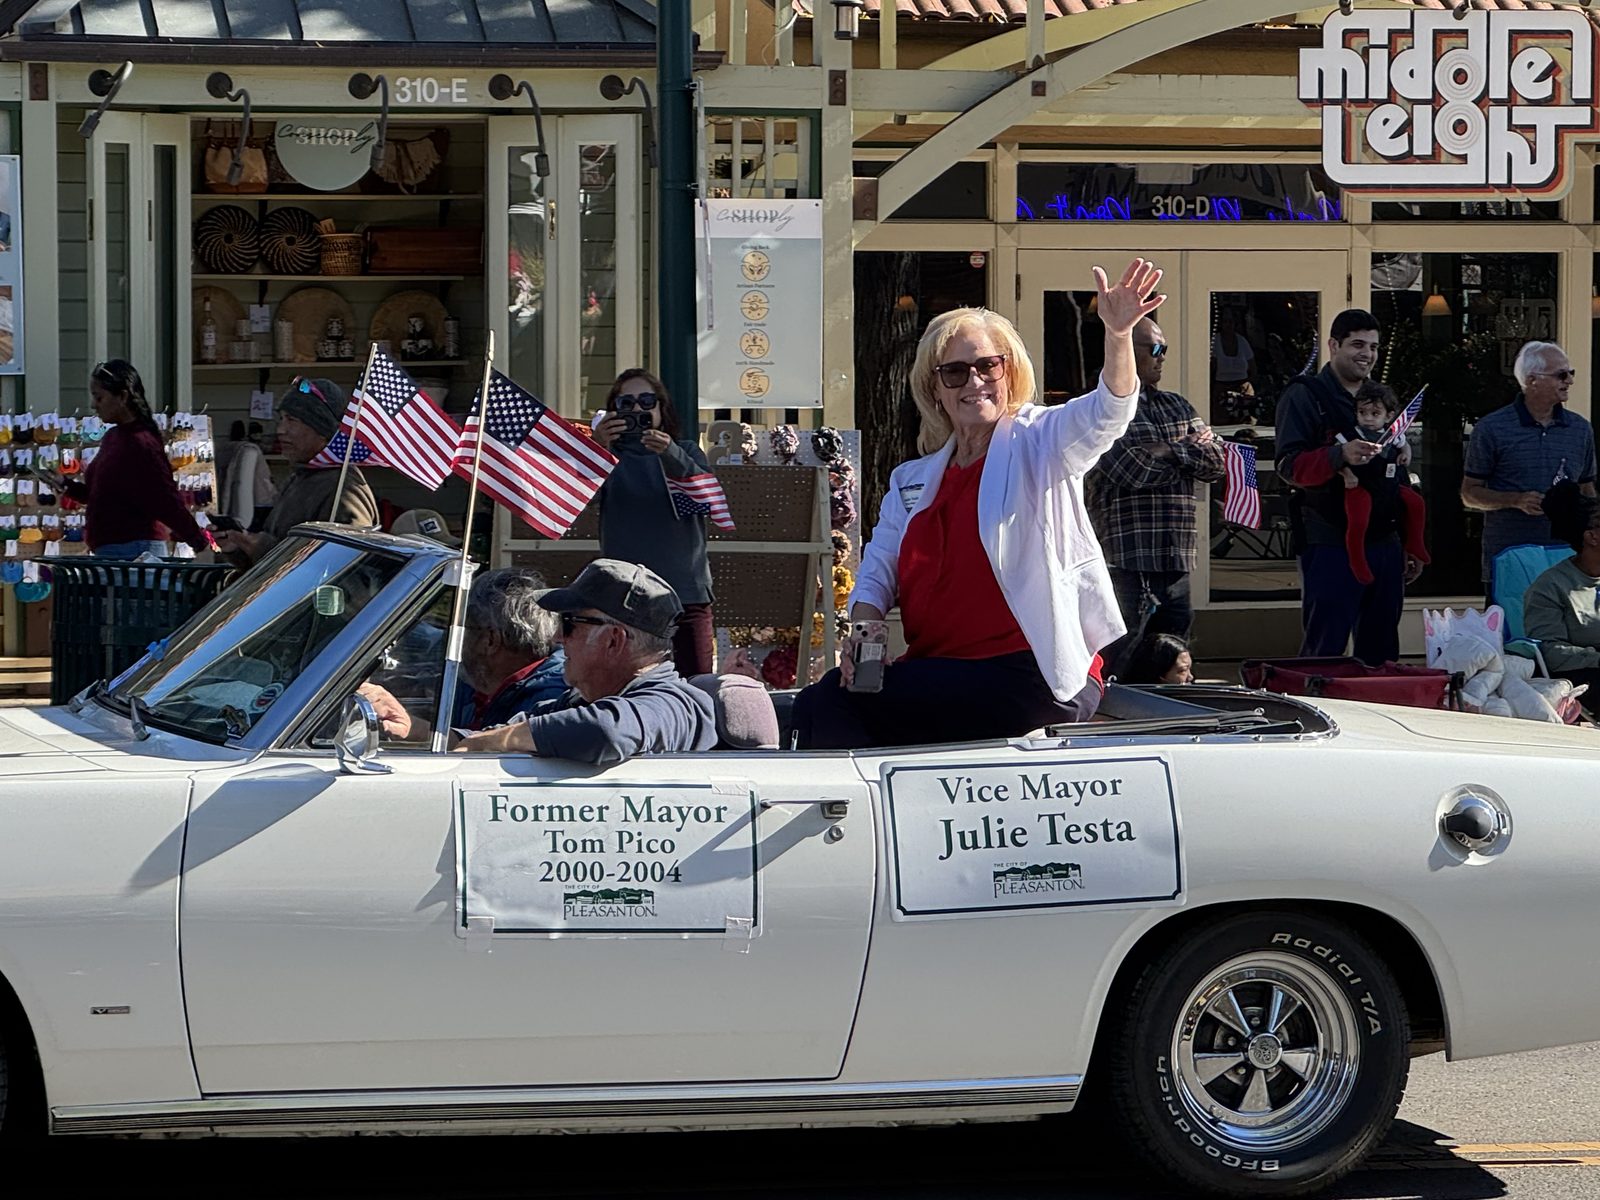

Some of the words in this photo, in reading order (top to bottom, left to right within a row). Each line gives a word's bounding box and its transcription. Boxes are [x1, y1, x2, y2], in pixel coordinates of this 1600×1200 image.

[1299, 9, 1592, 100] middle
[395, 77, 468, 103] 310-E
[296, 127, 358, 146] SHOP
[732, 209, 779, 223] SHOP
[1151, 195, 1210, 218] 310-D
[937, 777, 1009, 805] Vice
[1018, 773, 1123, 807] Mayor
[488, 794, 610, 823] Former
[621, 795, 728, 833] Mayor
[543, 830, 606, 854] Tom
[616, 830, 676, 854] Pico
[938, 815, 1029, 861] Julie
[1037, 812, 1136, 846] Testa
[539, 860, 683, 884] 2000-2004
[993, 879, 1083, 899] PLEASANTON
[563, 905, 655, 920] PLEASANTON
[1271, 932, 1362, 985] Radial
[1360, 991, 1382, 1036] T/A
[1155, 1056, 1280, 1172] BFGoodrich
